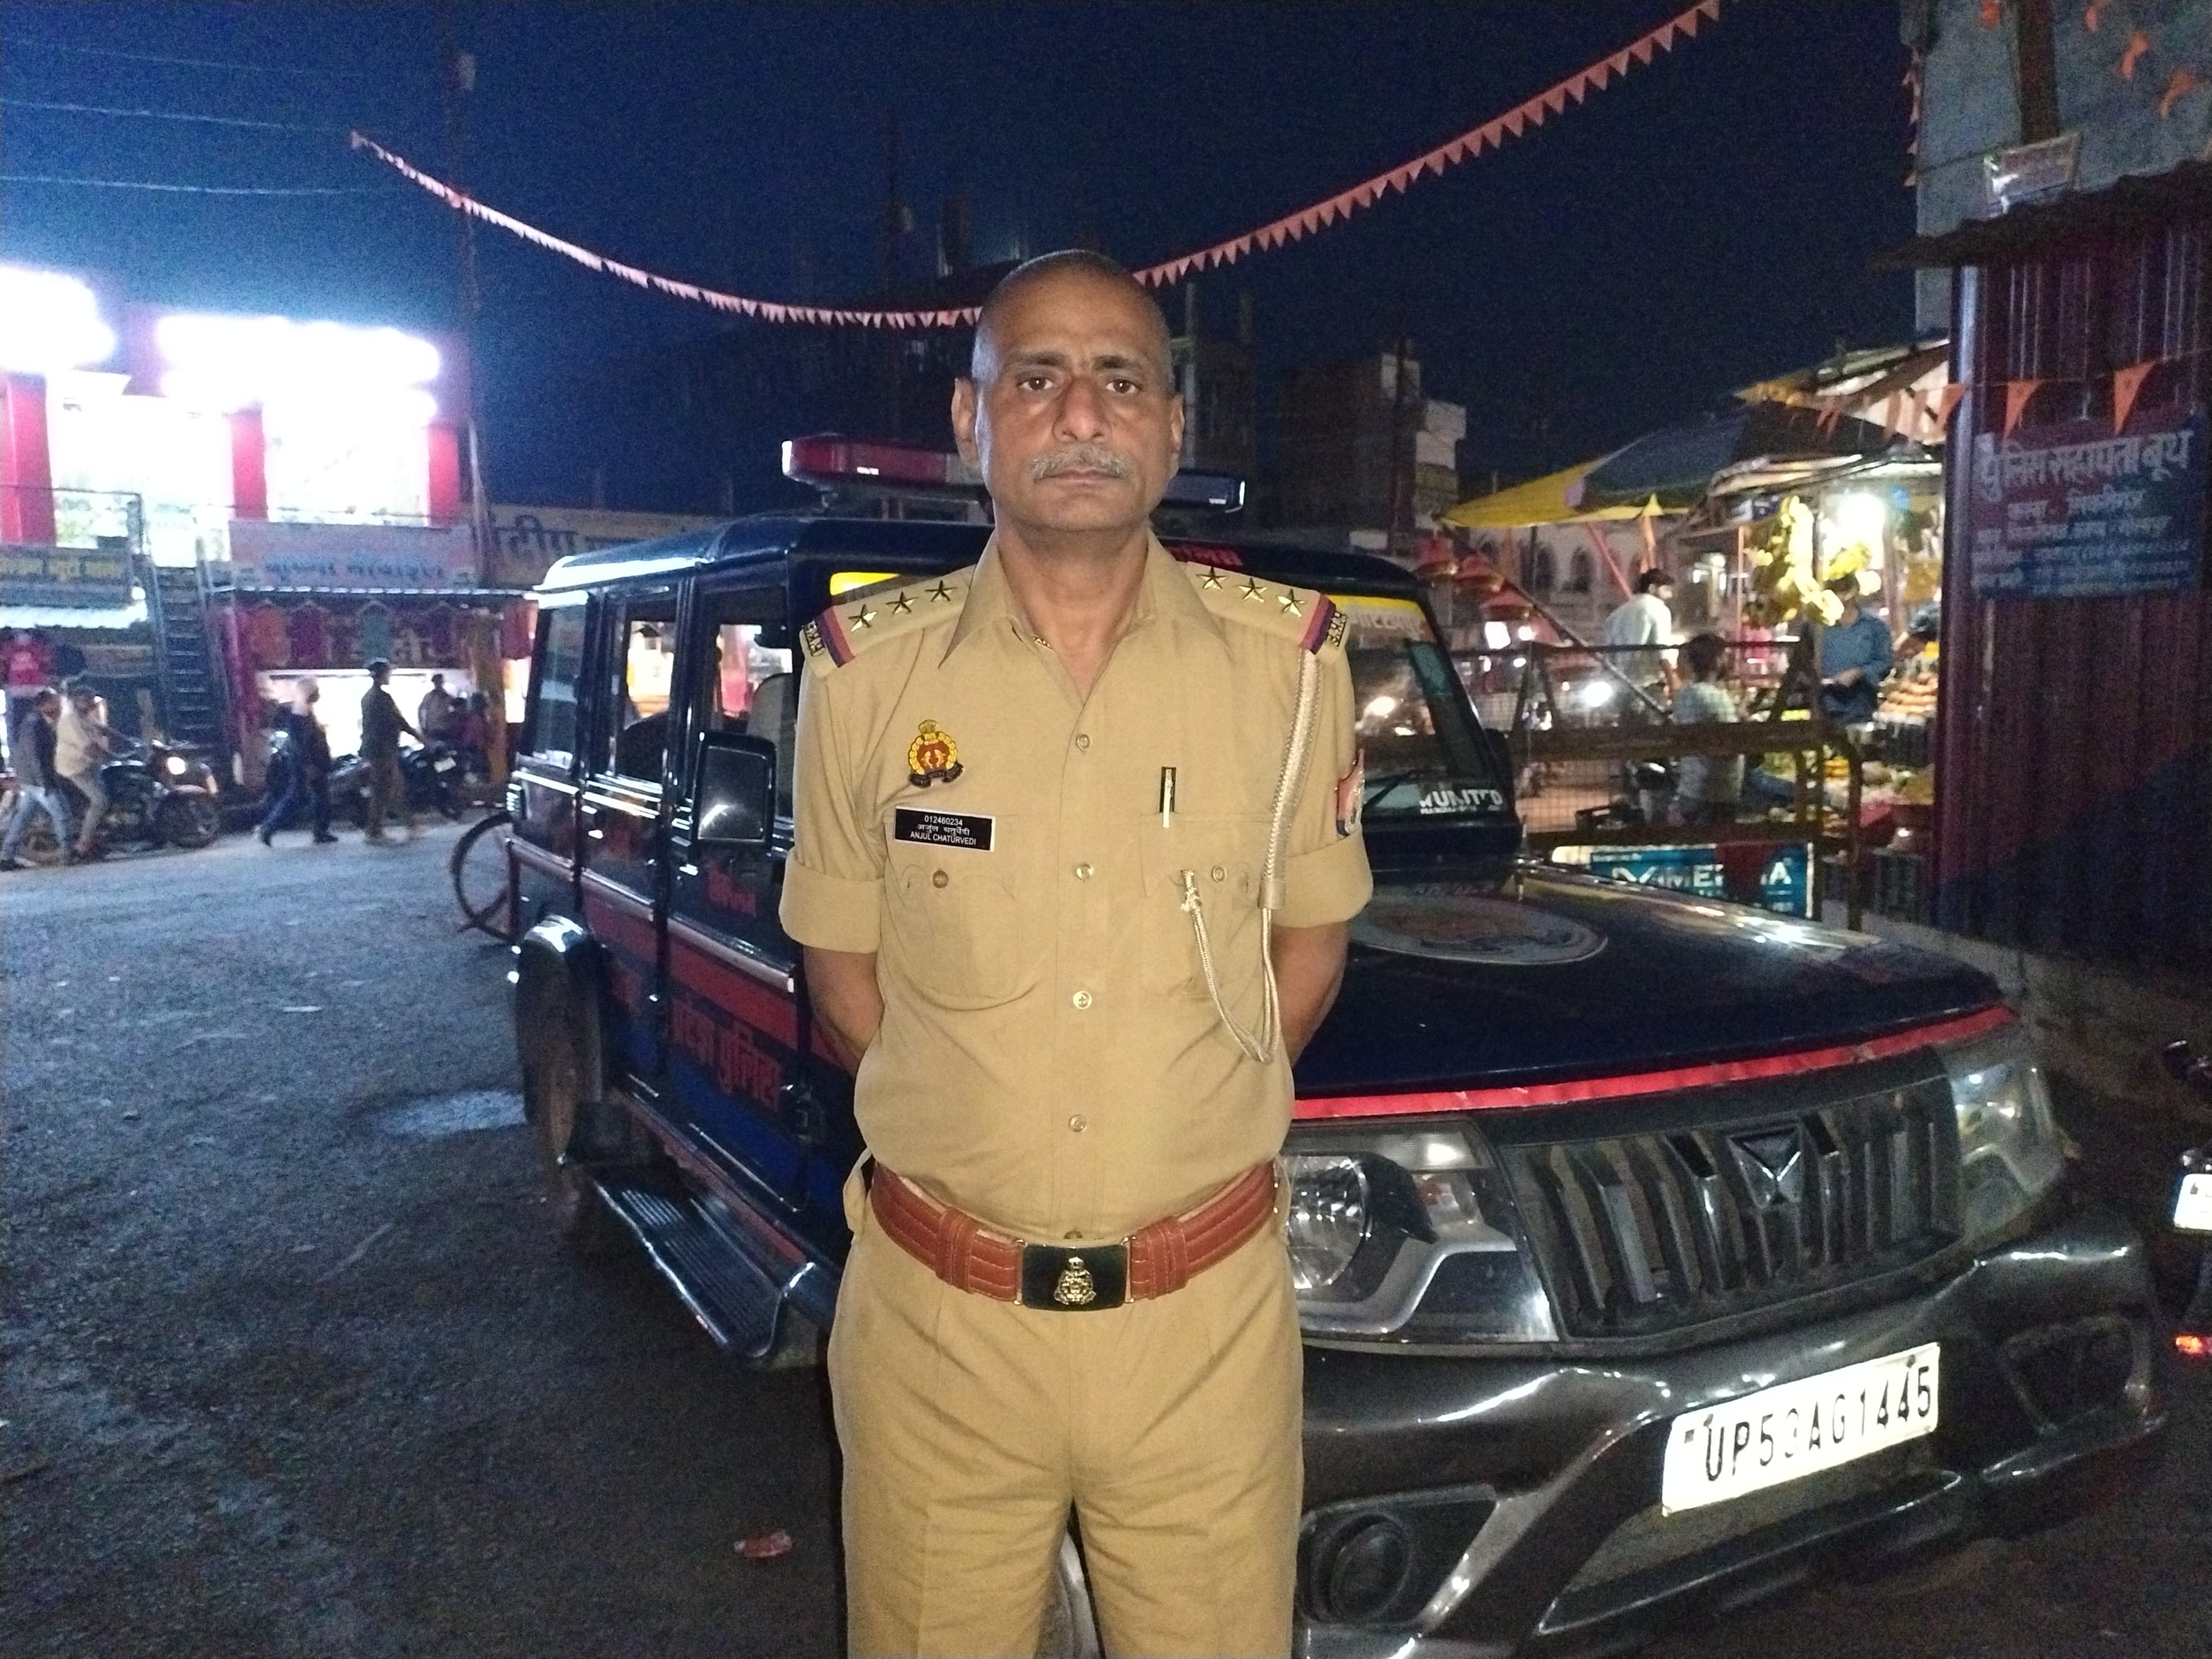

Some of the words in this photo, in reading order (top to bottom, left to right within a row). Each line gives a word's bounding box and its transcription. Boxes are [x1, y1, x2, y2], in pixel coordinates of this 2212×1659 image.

[924, 815, 963, 826] 012460234
[910, 831, 931, 840] ANJUL
[933, 834, 976, 846] CHATURVEDI
